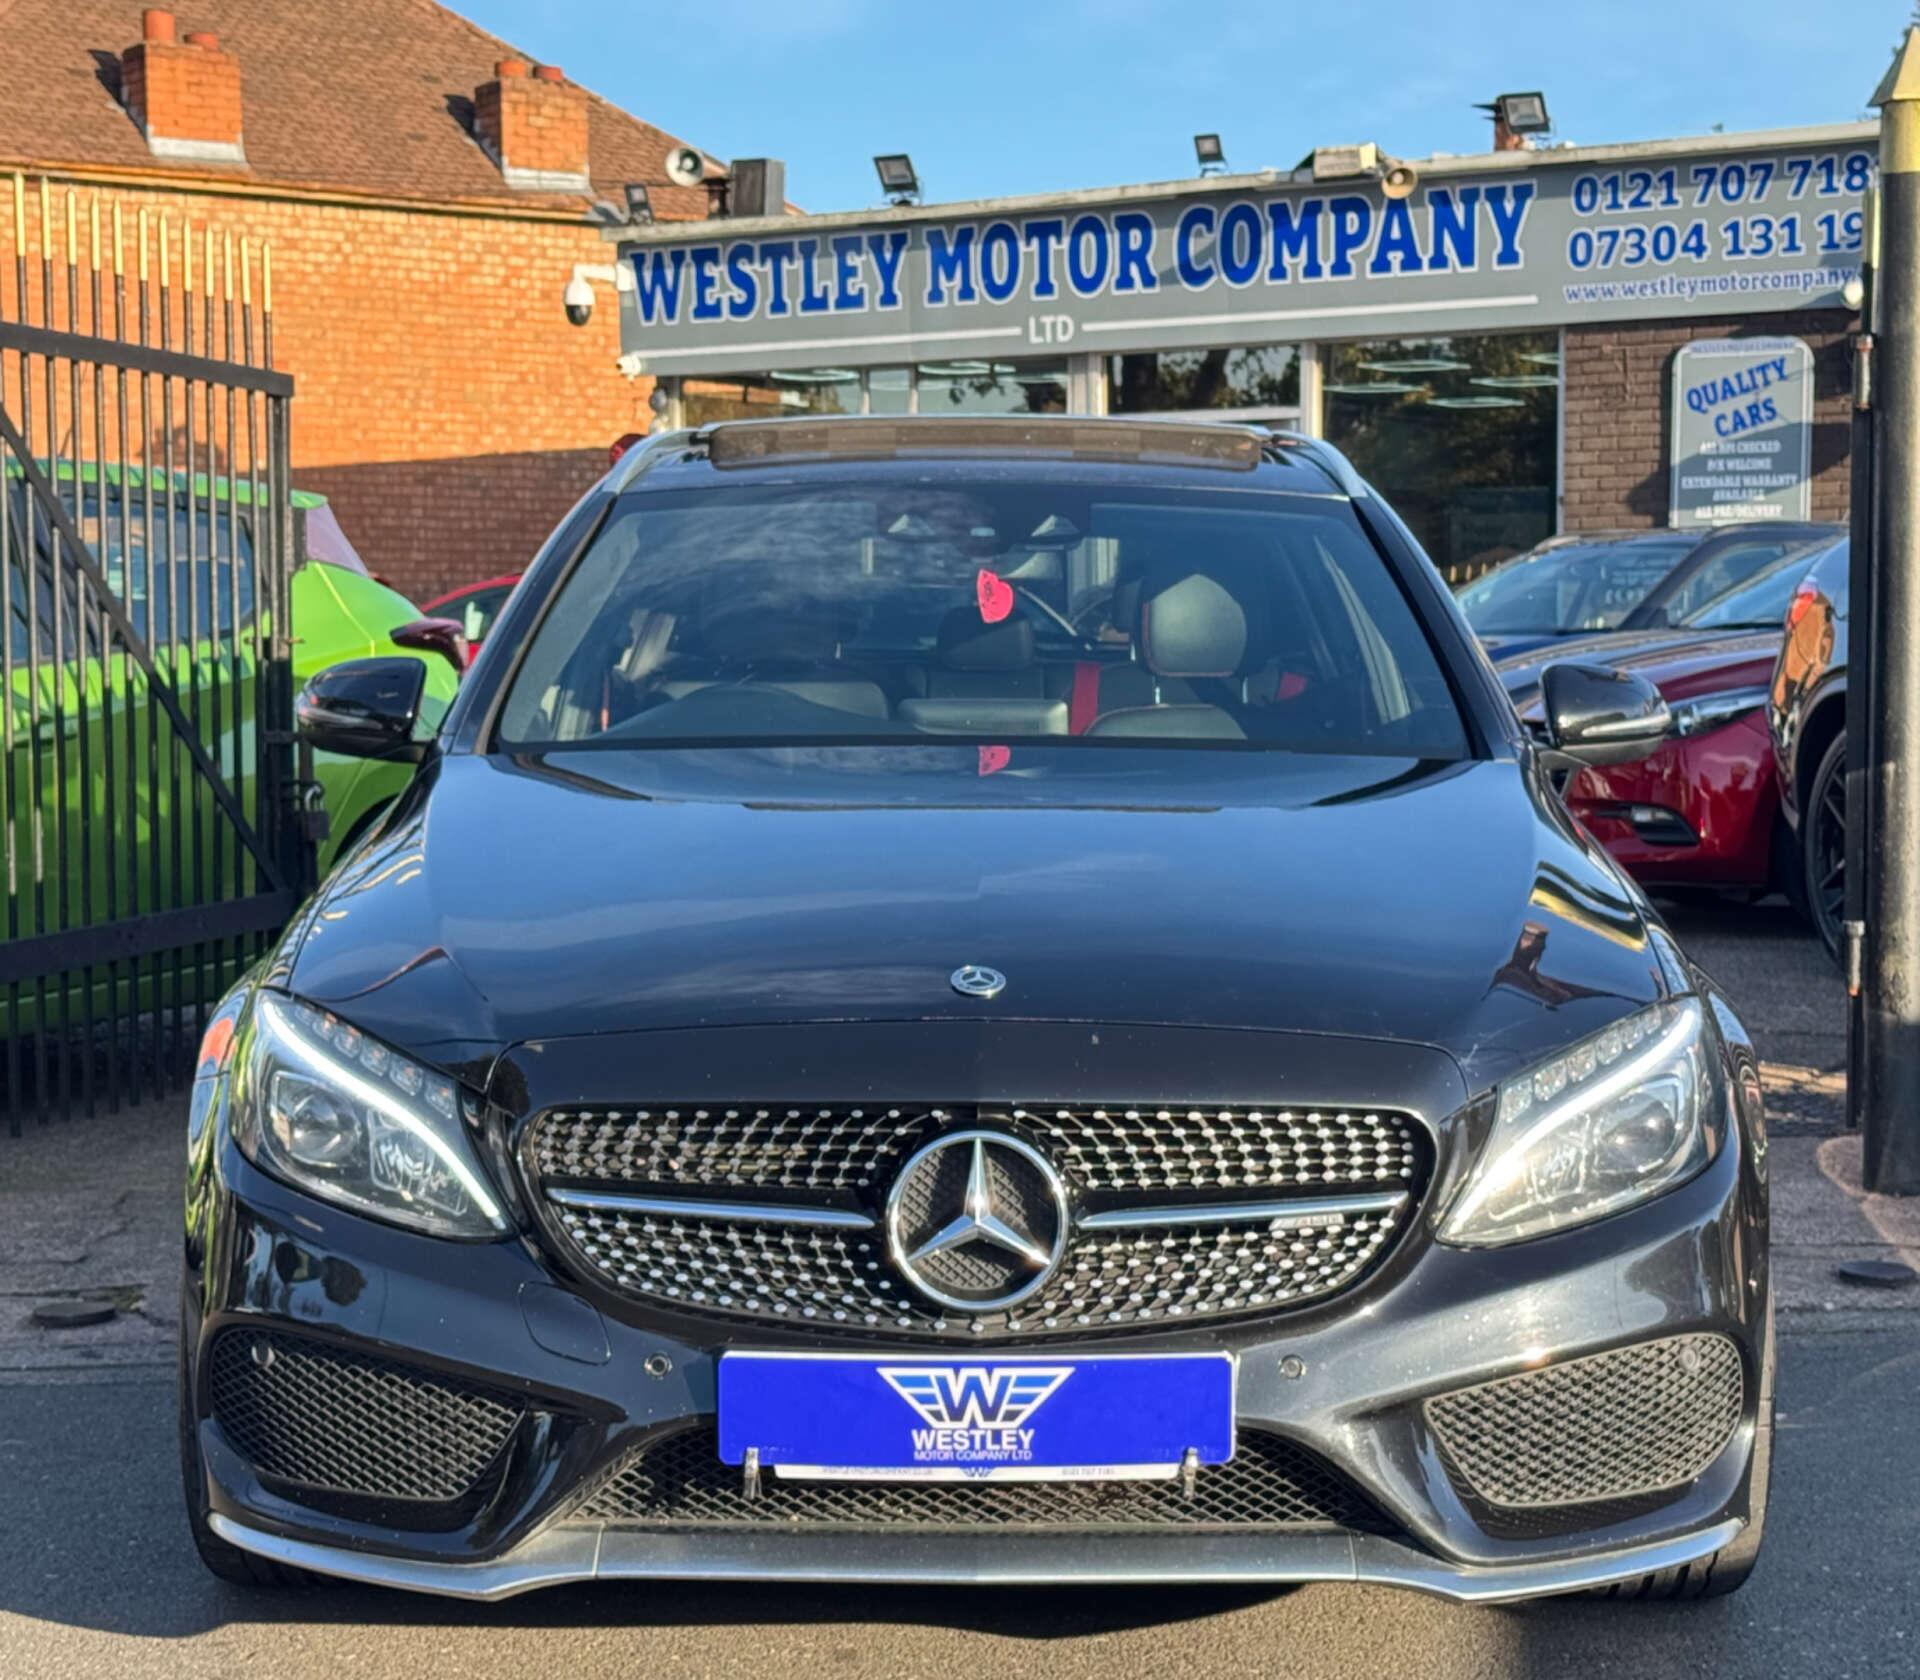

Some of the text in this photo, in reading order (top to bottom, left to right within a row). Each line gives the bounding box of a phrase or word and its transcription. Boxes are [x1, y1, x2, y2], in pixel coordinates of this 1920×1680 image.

[1573, 152, 1879, 215] 0121 707 718
[630, 180, 1537, 326] WESTLEY MOTOR COMPANY
[1568, 220, 1708, 270] 07304
[1722, 214, 1804, 260] 131
[1028, 315, 1076, 344] LTD
[1686, 355, 1789, 415] QUALITY
[1713, 397, 1778, 437] CARS
[911, 1428, 1035, 1451] WESTLEY
[914, 1450, 1033, 1461] MOTOR COMPANY LTD
